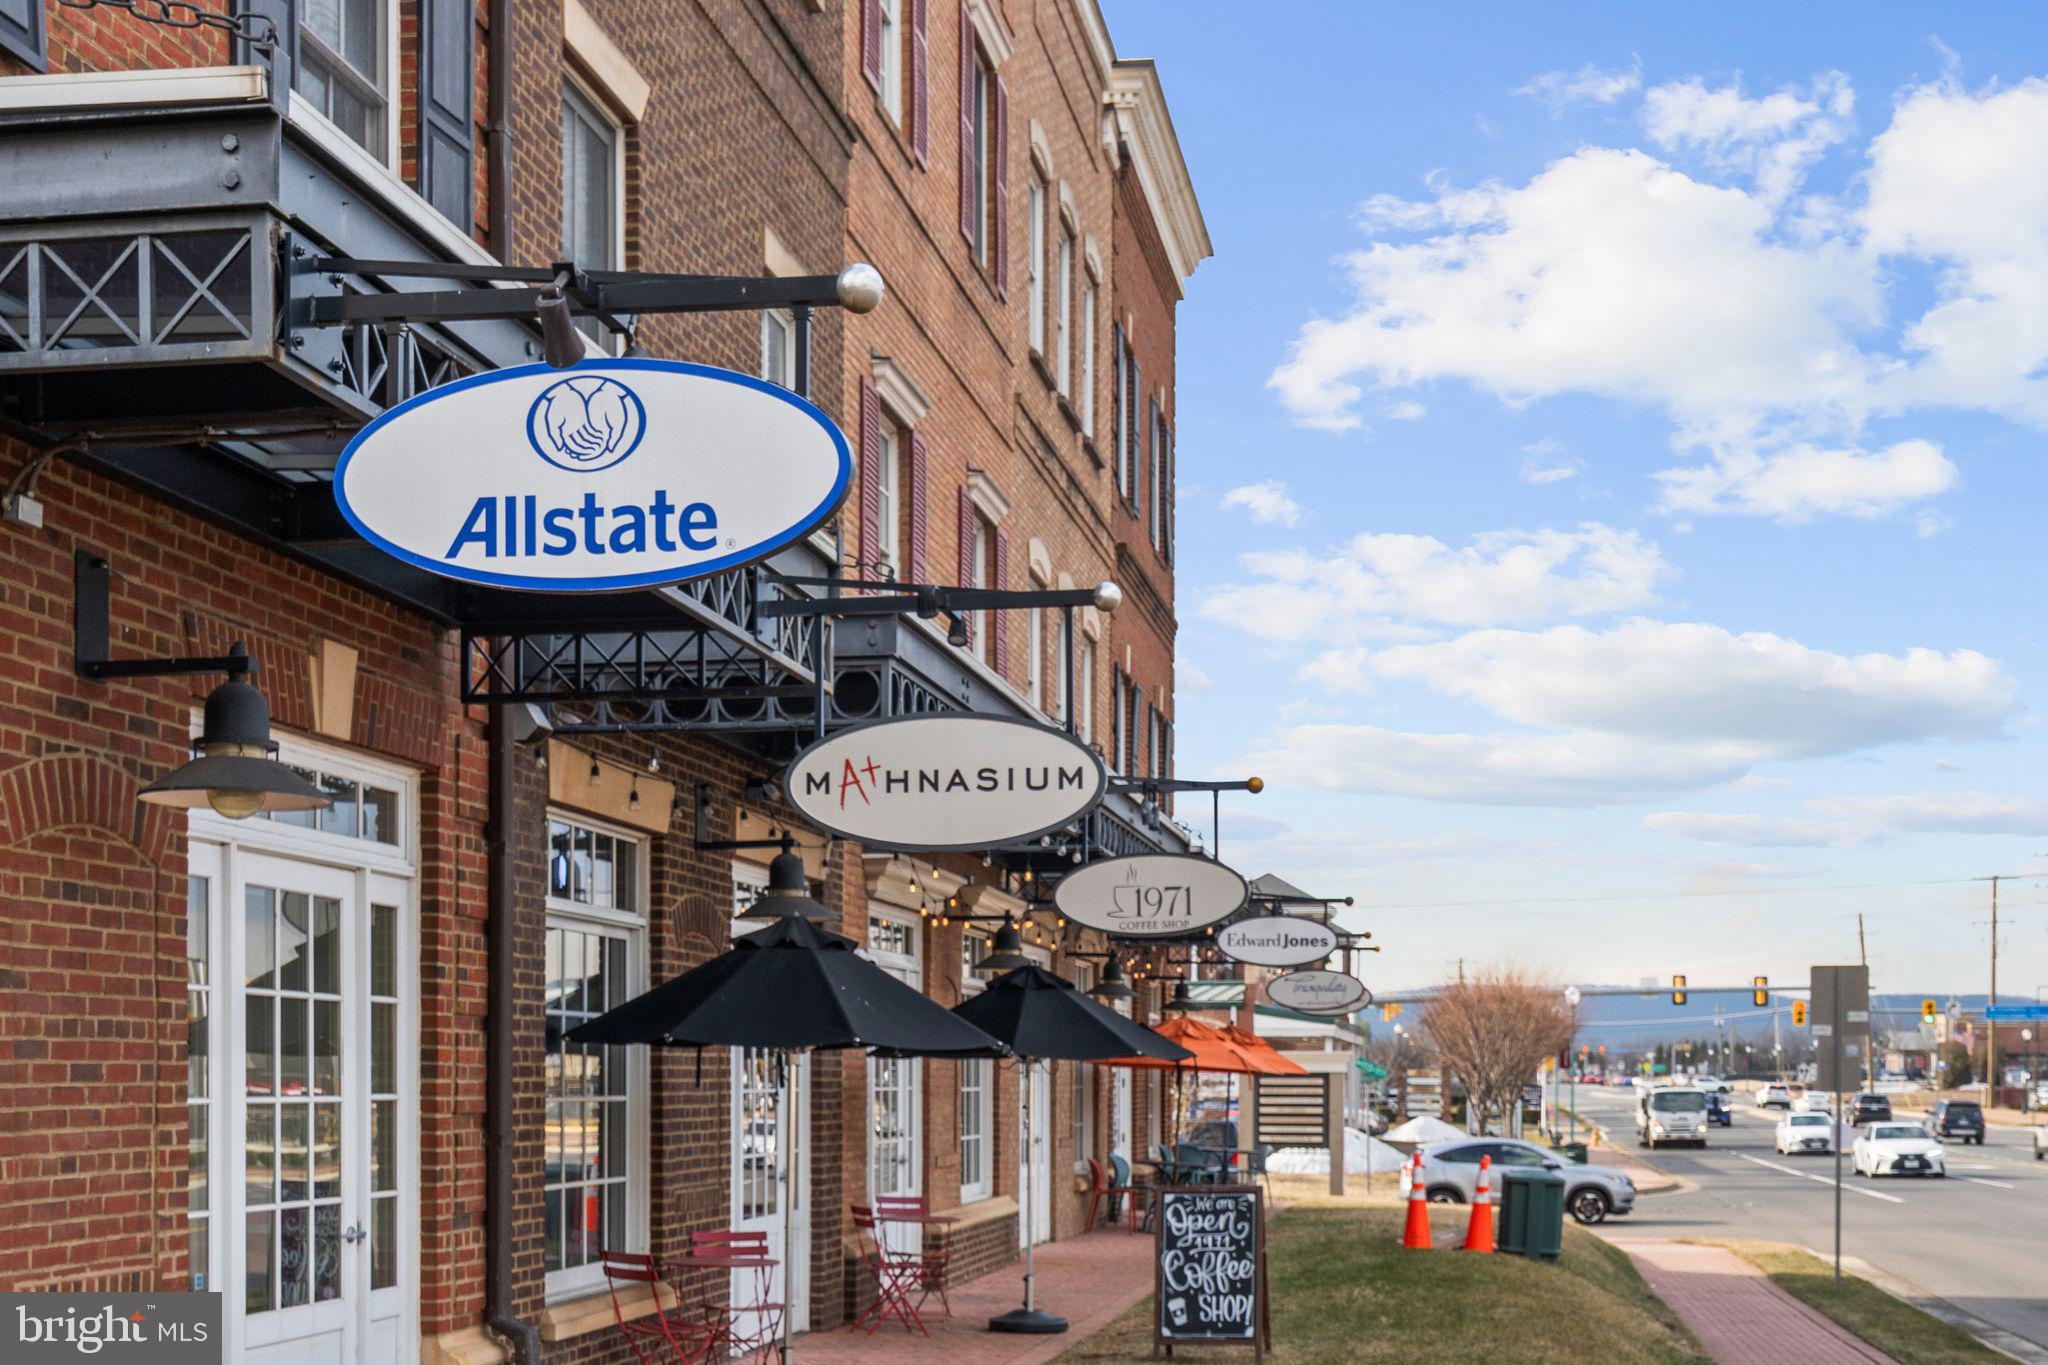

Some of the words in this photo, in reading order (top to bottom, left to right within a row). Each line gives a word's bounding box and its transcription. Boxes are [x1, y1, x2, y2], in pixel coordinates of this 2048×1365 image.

[444, 490, 718, 560] Allstate
[1134, 885, 1193, 918] 1971
[1118, 920, 1159, 931] COFFEE
[1161, 919, 1190, 930] SHOP
[1227, 933, 1281, 948] Edward
[1282, 934, 1329, 949] Jones
[1195, 1197, 1214, 1212] We
[1166, 1203, 1249, 1247] Open
[1164, 1249, 1255, 1294] Coffee
[1198, 1294, 1255, 1326] SHOP!
